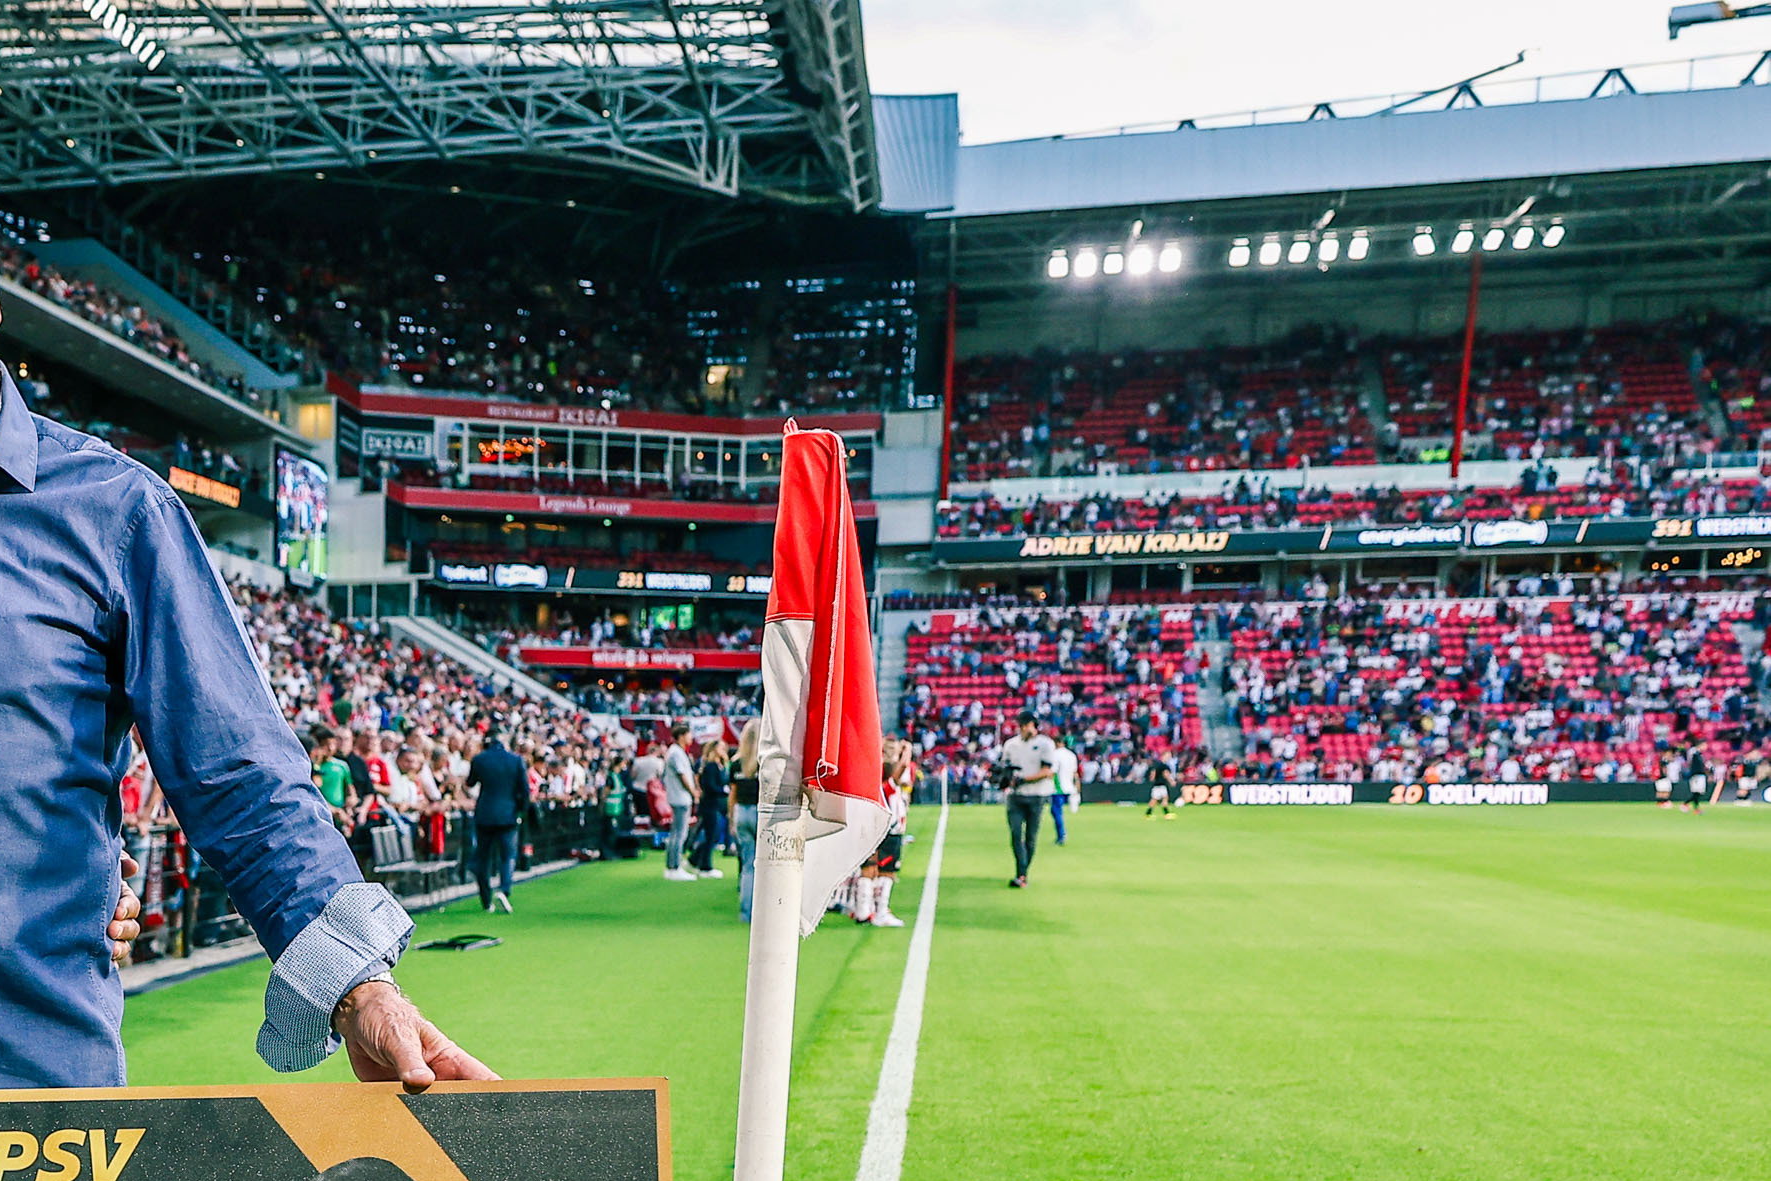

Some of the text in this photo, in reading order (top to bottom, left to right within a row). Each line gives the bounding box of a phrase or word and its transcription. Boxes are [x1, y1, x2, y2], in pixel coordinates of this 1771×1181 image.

[558, 407, 619, 426] IKIGAI
[1020, 531, 1229, 557] ADRIE VAN KRAAIJ
[1230, 783, 1354, 805] WEDSTRIJDEN
[1388, 783, 1425, 805] 10
[1429, 783, 1549, 805] DOELPUNTEN
